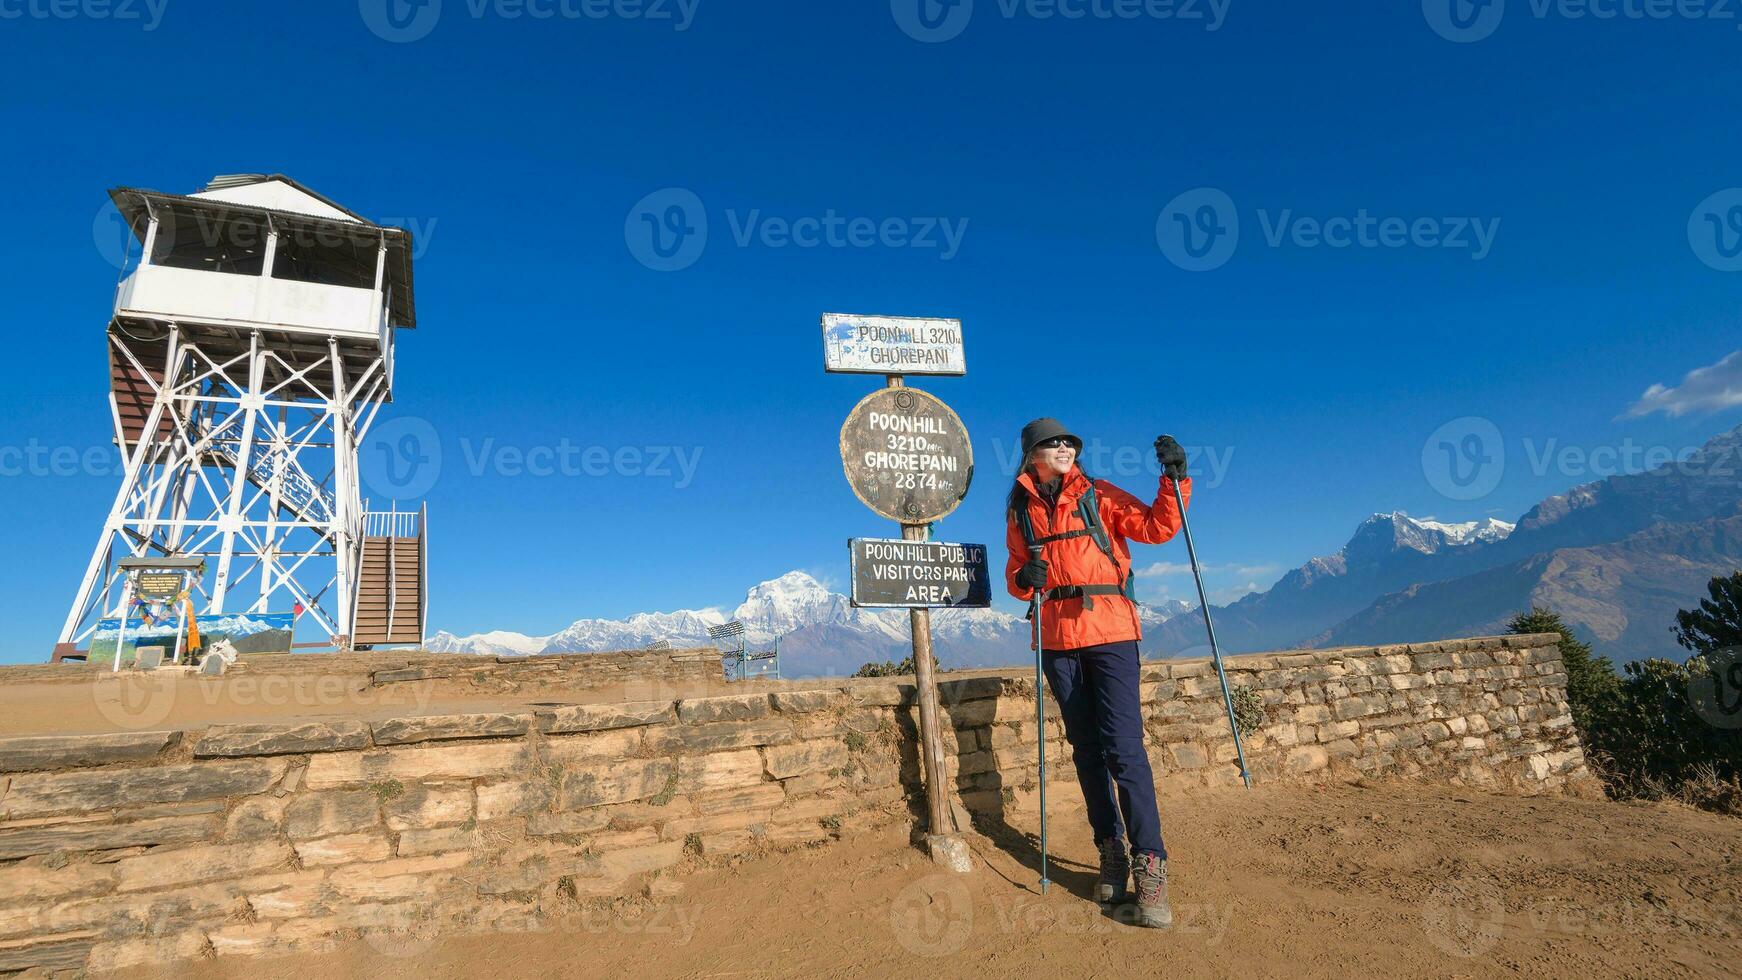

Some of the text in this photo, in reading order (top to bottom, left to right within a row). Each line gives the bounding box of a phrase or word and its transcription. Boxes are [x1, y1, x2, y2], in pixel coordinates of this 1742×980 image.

[871, 347, 949, 364] GHOREPANI
[864, 451, 957, 472] GHOREPANI
[895, 472, 937, 490] 2874
[865, 543, 981, 563] POON HILL PUBLIC
[905, 585, 952, 602] AREA
